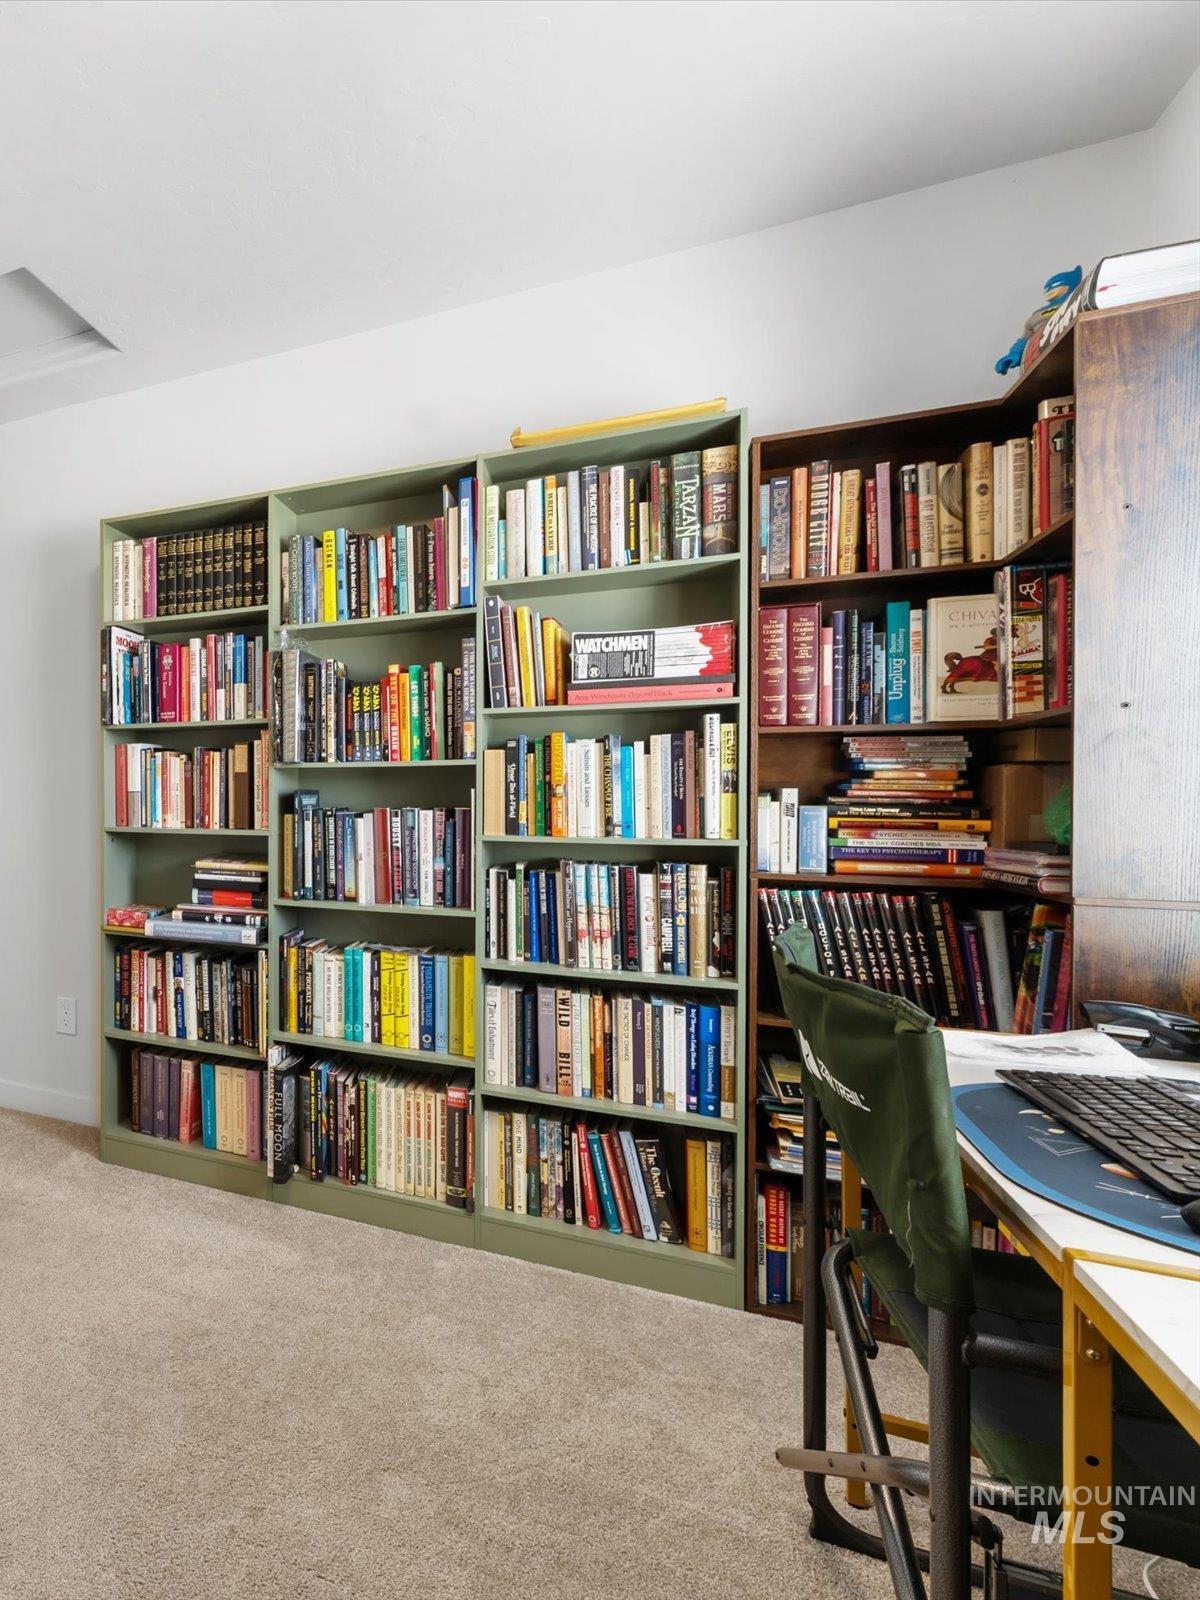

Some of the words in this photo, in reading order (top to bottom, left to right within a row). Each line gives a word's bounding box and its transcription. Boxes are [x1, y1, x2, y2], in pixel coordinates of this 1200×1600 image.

[590, 484, 598, 493] THE
[810, 475, 828, 516] DODGE
[849, 480, 857, 497] GREAT
[590, 494, 598, 517] PRACTICE
[674, 475, 700, 538] TARZAN
[712, 483, 727, 523] MARS
[920, 499, 936, 512] BAT
[590, 525, 598, 554] HYPNOTISM
[810, 520, 828, 547] CITY
[920, 514, 936, 554] MASTERSON
[325, 539, 334, 569] BATMAN
[428, 553, 435, 563] no
[575, 635, 649, 654] WATCHMEN
[390, 677, 398, 690] SEX
[411, 682, 419, 695] LET
[888, 658, 907, 701] Unplug
[390, 694, 398, 704] ON
[411, 696, 419, 717] THEM
[390, 711, 398, 723] THE
[390, 725, 398, 750] BRAIN
[726, 731, 738, 764] ELVIS
[604, 754, 612, 769] THE
[604, 769, 612, 793] CHASM
[604, 793, 612, 801] OF
[604, 802, 612, 818] FIRE
[565, 878, 573, 910] Mindfulness
[565, 918, 573, 942] Hypnosis
[661, 917, 673, 953] CAMPBELL
[818, 923, 833, 965] DOCTOR
[834, 926, 844, 946] ALL
[841, 949, 853, 977] STAR
[848, 927, 858, 947] ALL
[855, 951, 868, 980] STAR
[861, 928, 872, 948] ALL
[869, 952, 880, 980] STAR
[873, 928, 883, 948] ALL
[879, 952, 891, 980] STAR
[887, 928, 898, 949] ALL
[894, 953, 906, 981] STAR
[903, 932, 913, 953] ALL
[909, 956, 922, 985] STAR
[917, 931, 926, 951] ALL
[922, 955, 934, 984] STAR
[176, 995, 184, 1003] NO
[305, 971, 313, 1003] PHOENIX
[176, 1003, 184, 1029] APOLOGY
[425, 1003, 434, 1026] TRANCES
[559, 998, 570, 1028] WILD
[559, 1052, 570, 1078] BILL
[268, 1097, 275, 1109] ON
[274, 1092, 283, 1119] FULL
[427, 1114, 433, 1122] OF
[440, 1118, 447, 1126] ON
[274, 1123, 283, 1161] MOON
[646, 1145, 658, 1167] The
[650, 1166, 666, 1198] Occult
